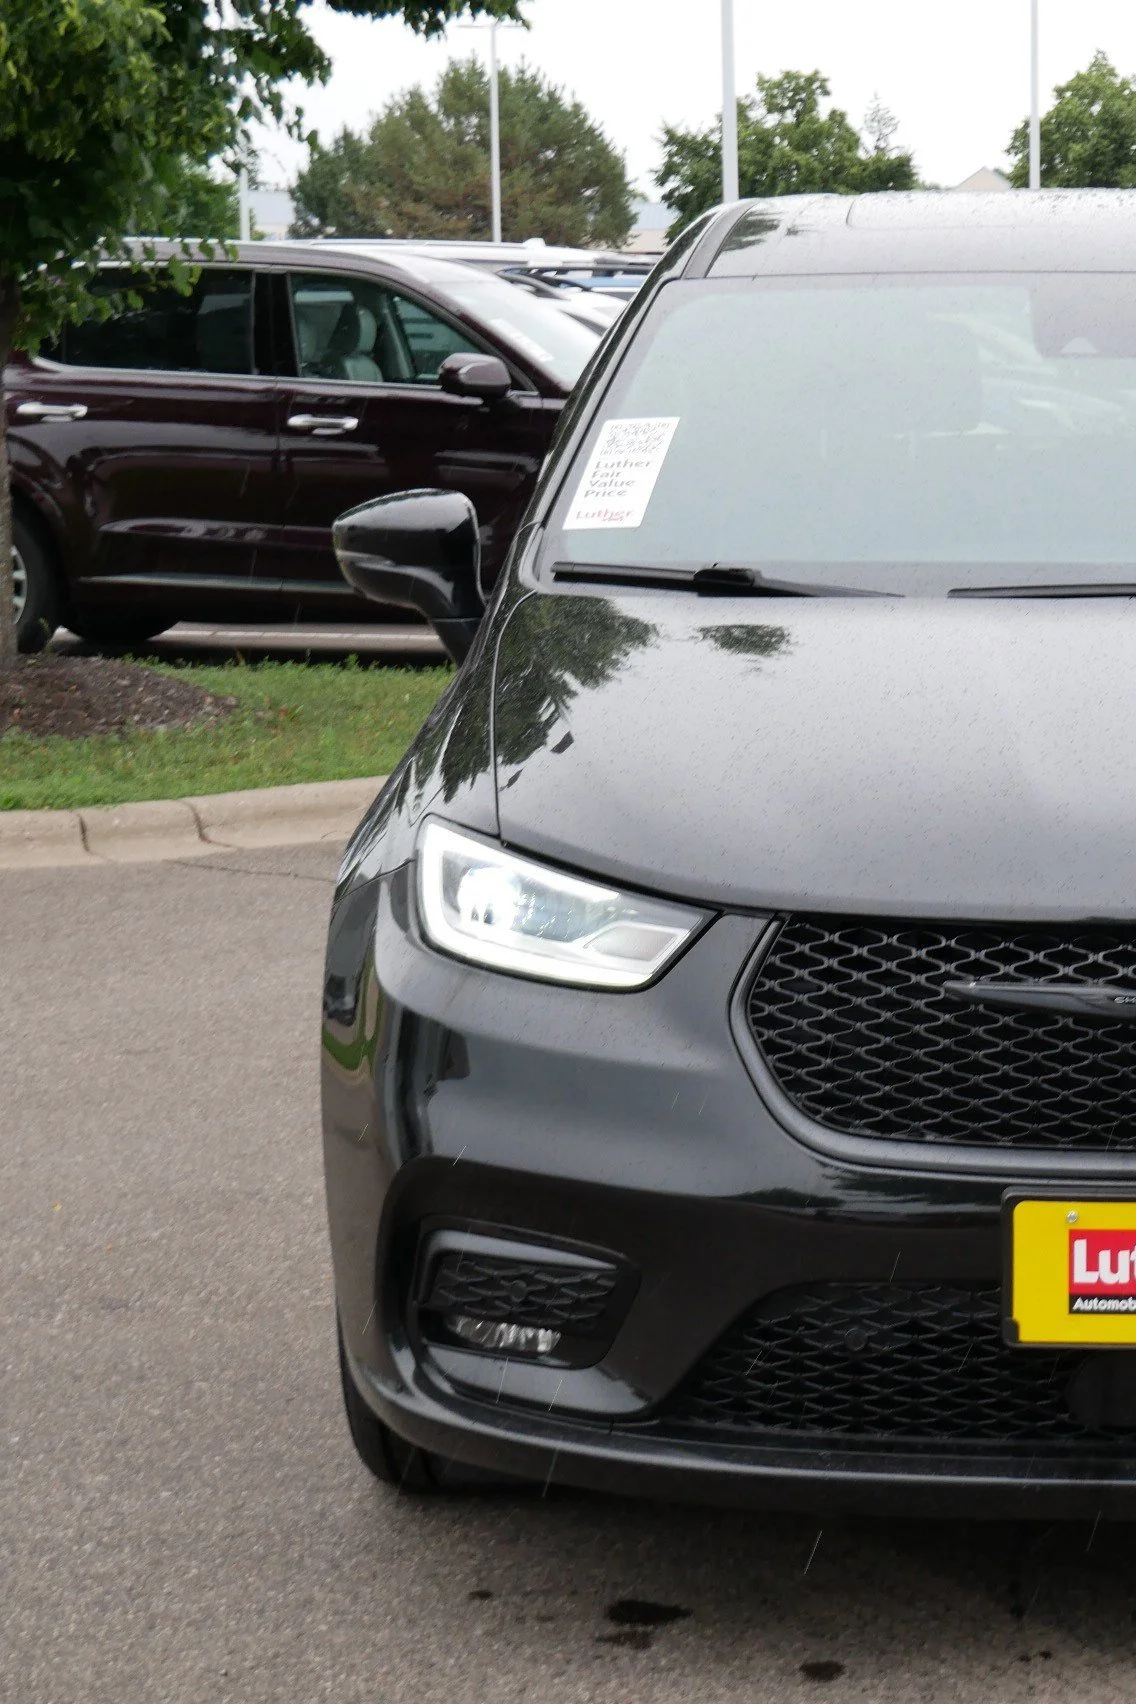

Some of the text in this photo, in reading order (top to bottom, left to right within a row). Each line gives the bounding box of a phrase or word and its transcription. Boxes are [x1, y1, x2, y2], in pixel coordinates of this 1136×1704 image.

[595, 459, 652, 469] Luther
[591, 470, 624, 478] Fair
[589, 479, 636, 488] Value
[584, 490, 628, 498] Price
[576, 509, 634, 519] Luther
